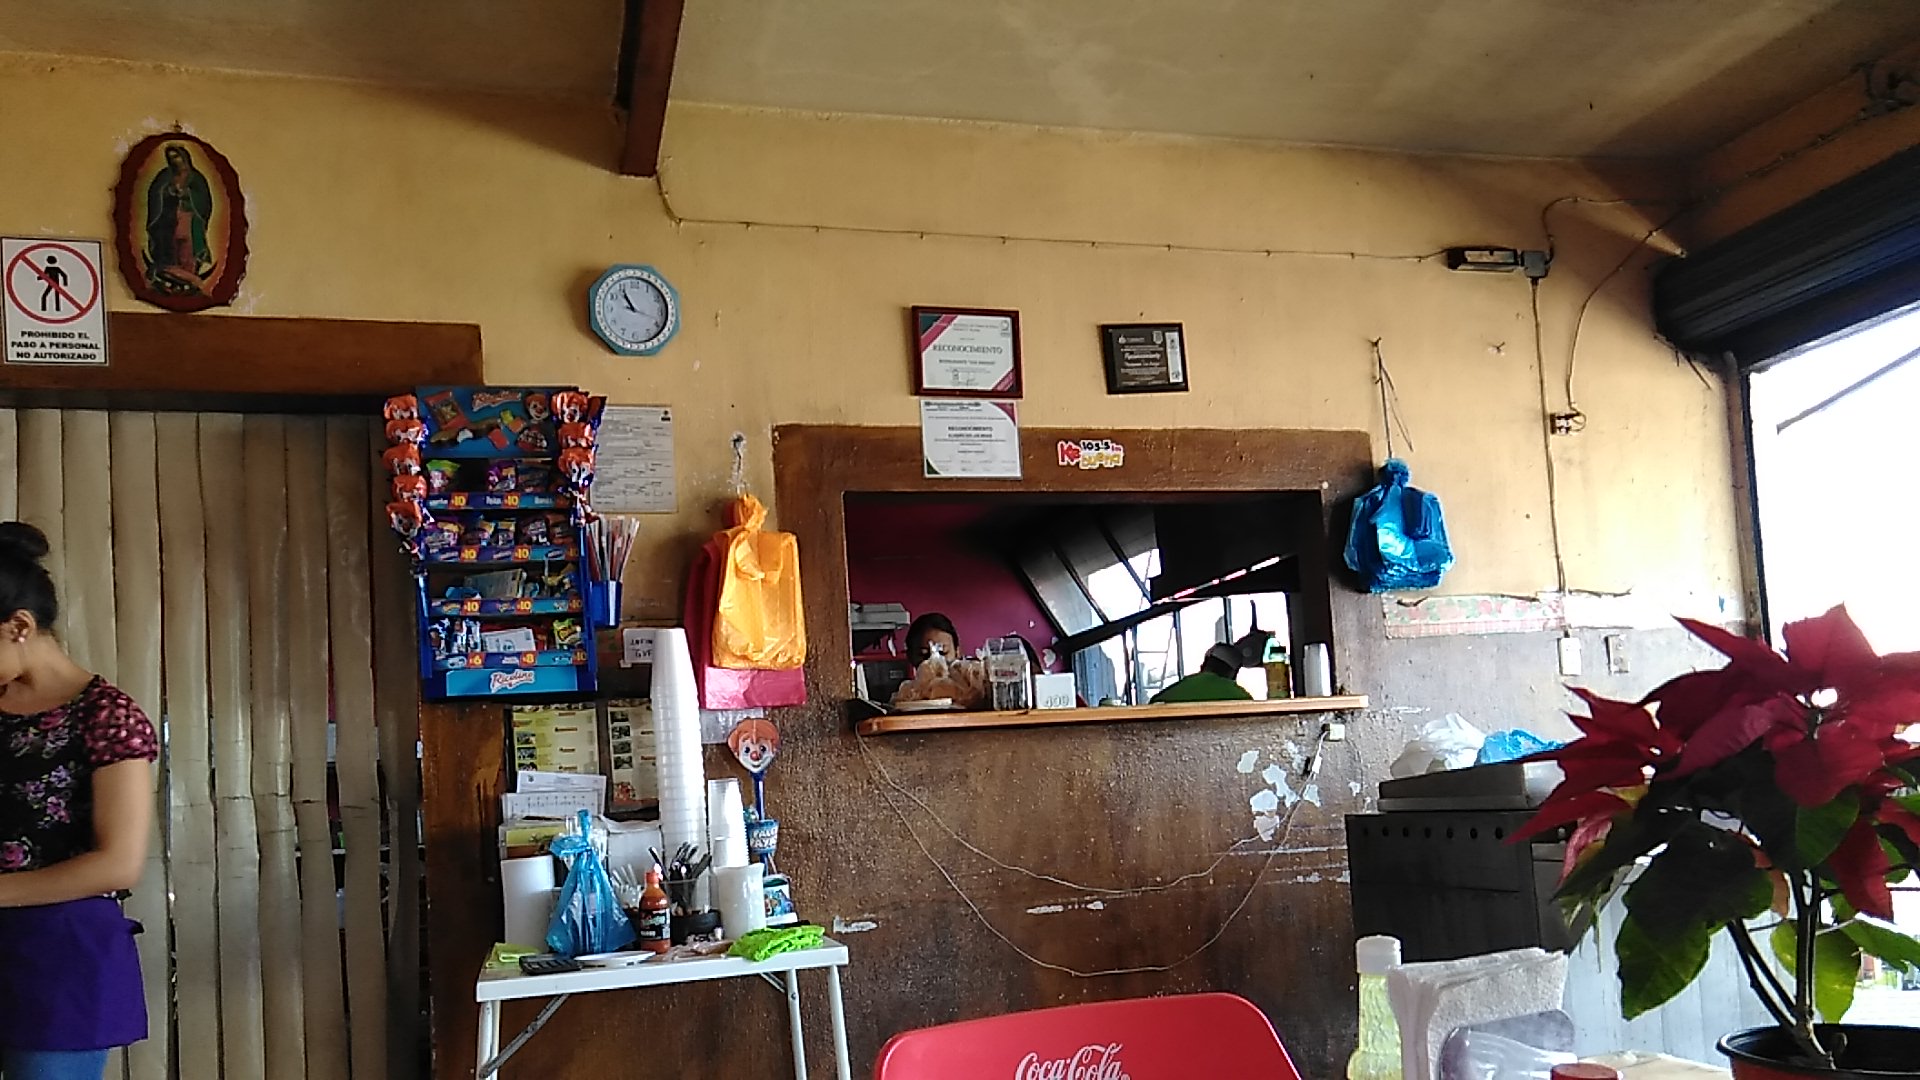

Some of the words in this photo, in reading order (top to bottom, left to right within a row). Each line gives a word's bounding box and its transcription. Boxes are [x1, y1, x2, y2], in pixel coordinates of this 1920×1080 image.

[49, 342, 101, 350] PERSONAL
[933, 344, 1003, 354] RECONOCIMIENTO
[16, 351, 31, 359] NO
[33, 352, 97, 360] AUTORIZADO
[491, 669, 534, 690] Ricolino
